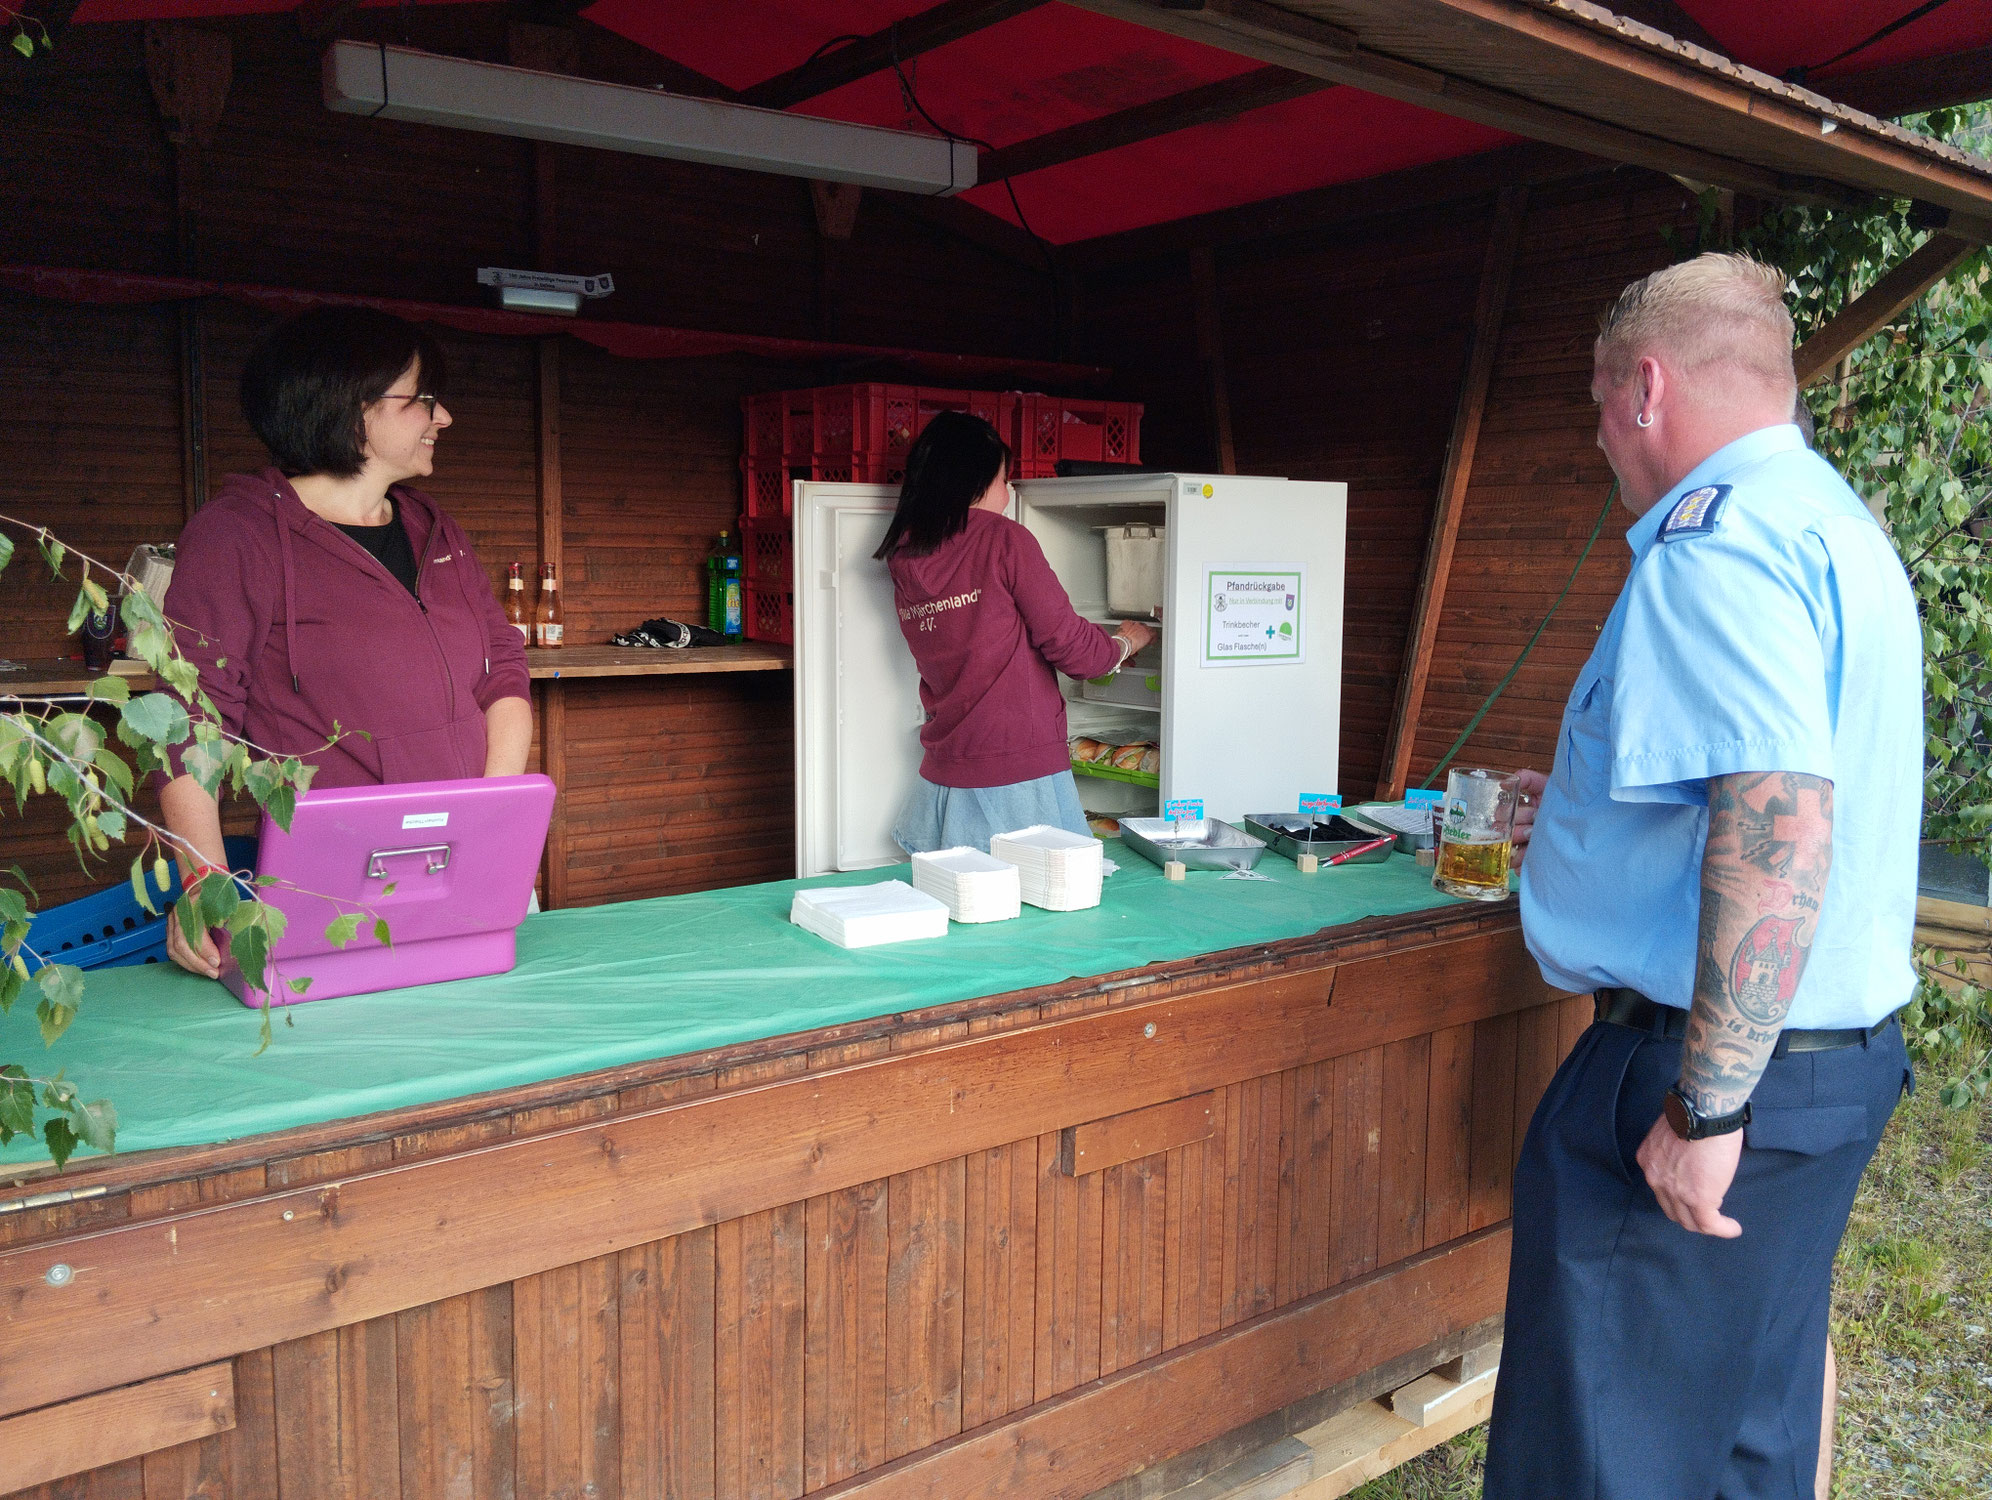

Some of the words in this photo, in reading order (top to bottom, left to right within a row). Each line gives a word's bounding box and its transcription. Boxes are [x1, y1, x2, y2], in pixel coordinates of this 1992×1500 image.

[1226, 581, 1286, 592] Pfandrückgabe
[920, 617, 937, 632] e.V.
[1222, 620, 1260, 629] Trinkbecher
[1217, 642, 1233, 651] Glas
[1234, 642, 1267, 652] Flasche(n)
